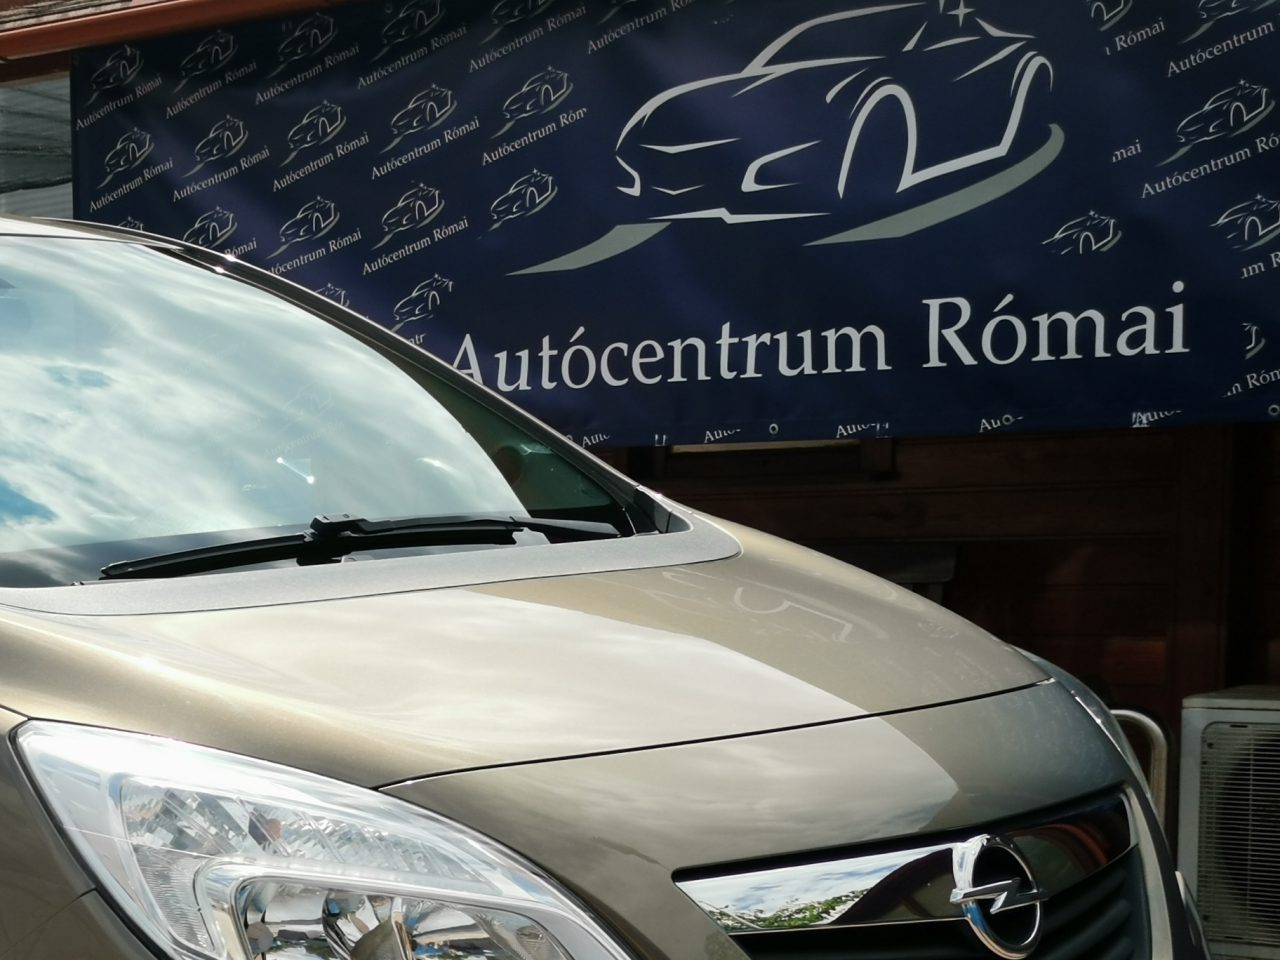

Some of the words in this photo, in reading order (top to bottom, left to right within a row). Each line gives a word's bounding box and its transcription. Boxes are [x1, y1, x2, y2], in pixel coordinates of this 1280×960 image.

[357, 46, 428, 90] Autócentrum
[430, 24, 468, 52] Római
[469, 26, 544, 73] Autócentrum
[546, 5, 587, 33] Római
[1115, 16, 1166, 51] Római
[1167, 21, 1275, 78] Autócentrum
[166, 79, 222, 119] Autócentrum
[224, 61, 258, 86] Római
[255, 64, 322, 105] Autócentrum
[324, 42, 360, 69] Római
[272, 152, 334, 192] Autócentrum
[335, 132, 370, 157] Római
[371, 138, 441, 180] Autócentrum
[443, 115, 480, 143] Római
[481, 122, 557, 167] Autócentrum
[1142, 147, 1252, 198] Autócentrum
[89, 177, 144, 213] Autócentrum
[143, 157, 174, 181] Római
[172, 166, 239, 203] Autócentrum
[240, 145, 270, 170] Római
[328, 228, 362, 253] Római
[362, 237, 431, 276] Autócentrum
[433, 216, 469, 243] Római
[452, 321, 892, 393] Autócentrum
[922, 280, 1191, 369] Római
